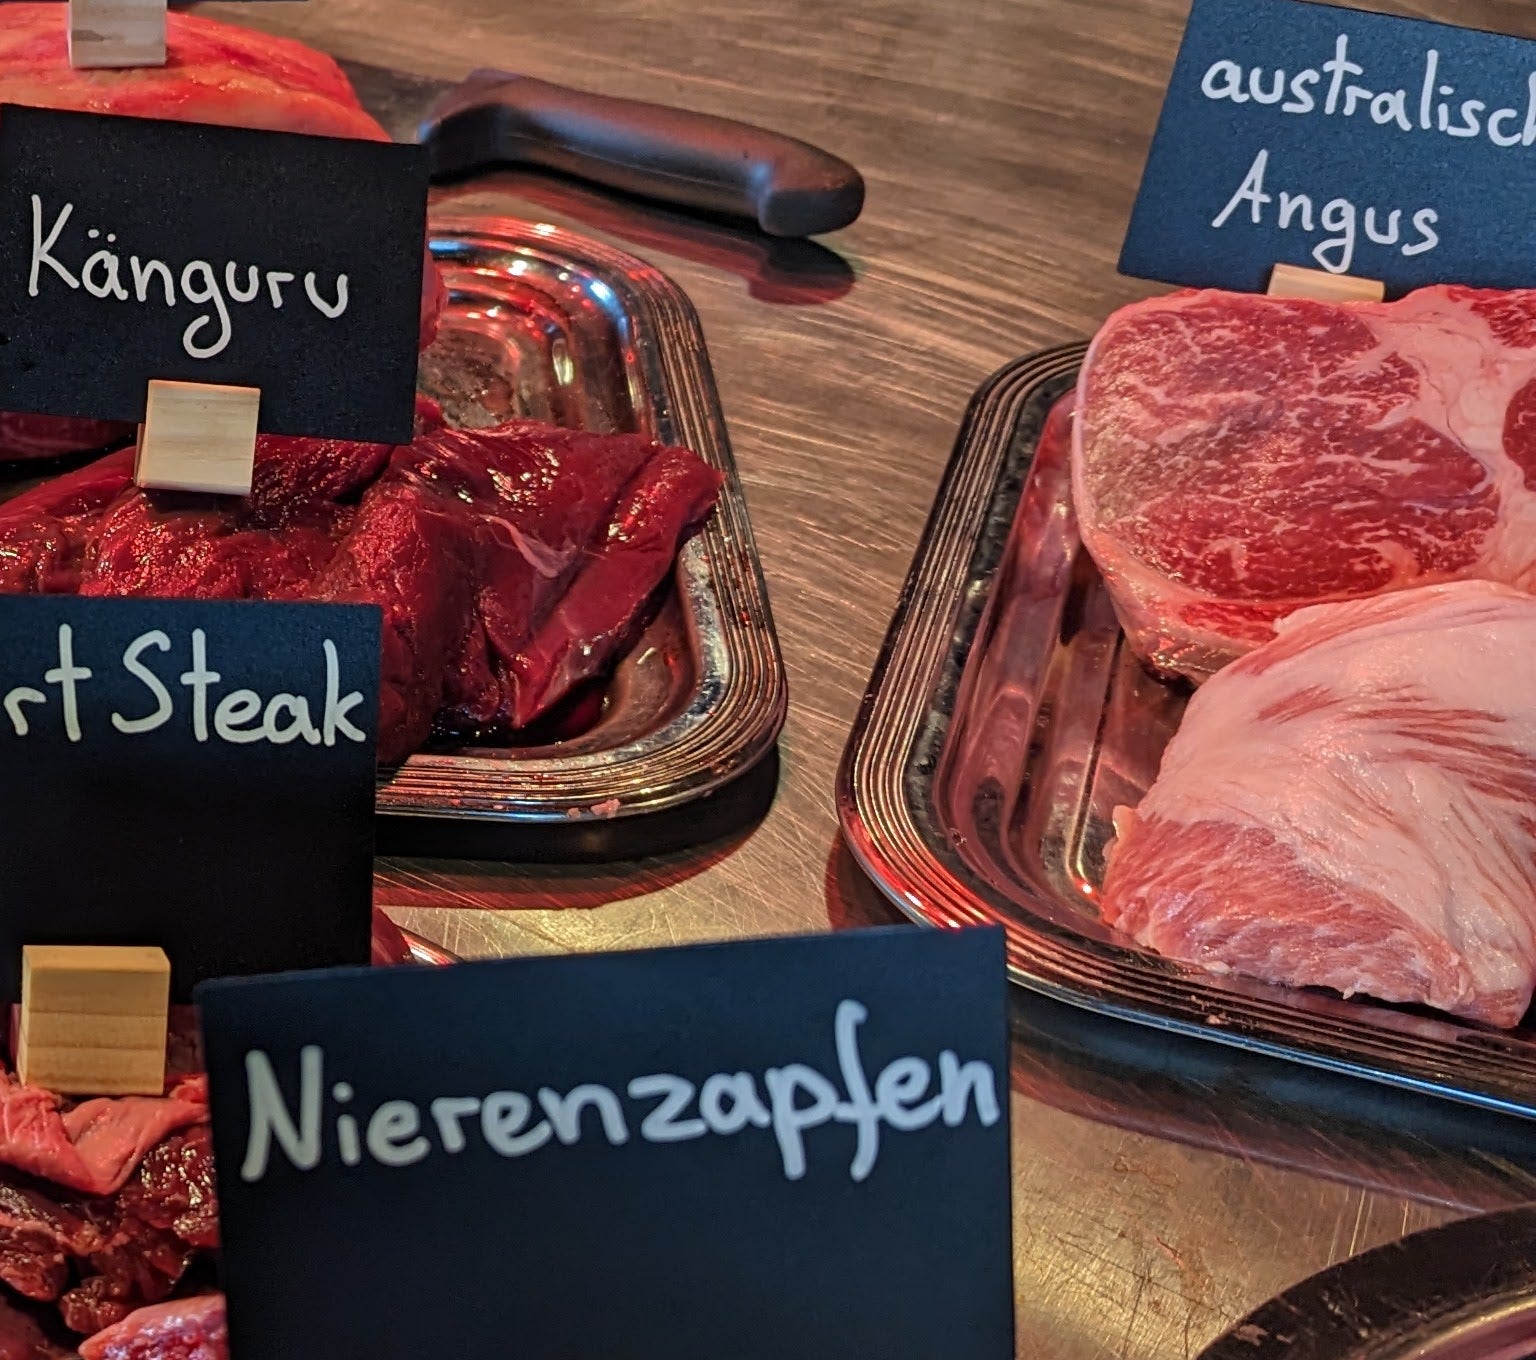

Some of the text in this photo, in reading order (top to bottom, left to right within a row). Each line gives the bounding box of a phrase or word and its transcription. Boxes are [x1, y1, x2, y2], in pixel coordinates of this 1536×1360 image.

[28, 194, 349, 359] Känguru
[1211, 149, 1440, 274] Angus
[111, 628, 367, 746] Steak
[239, 999, 1002, 1183] Nierenzapfen
